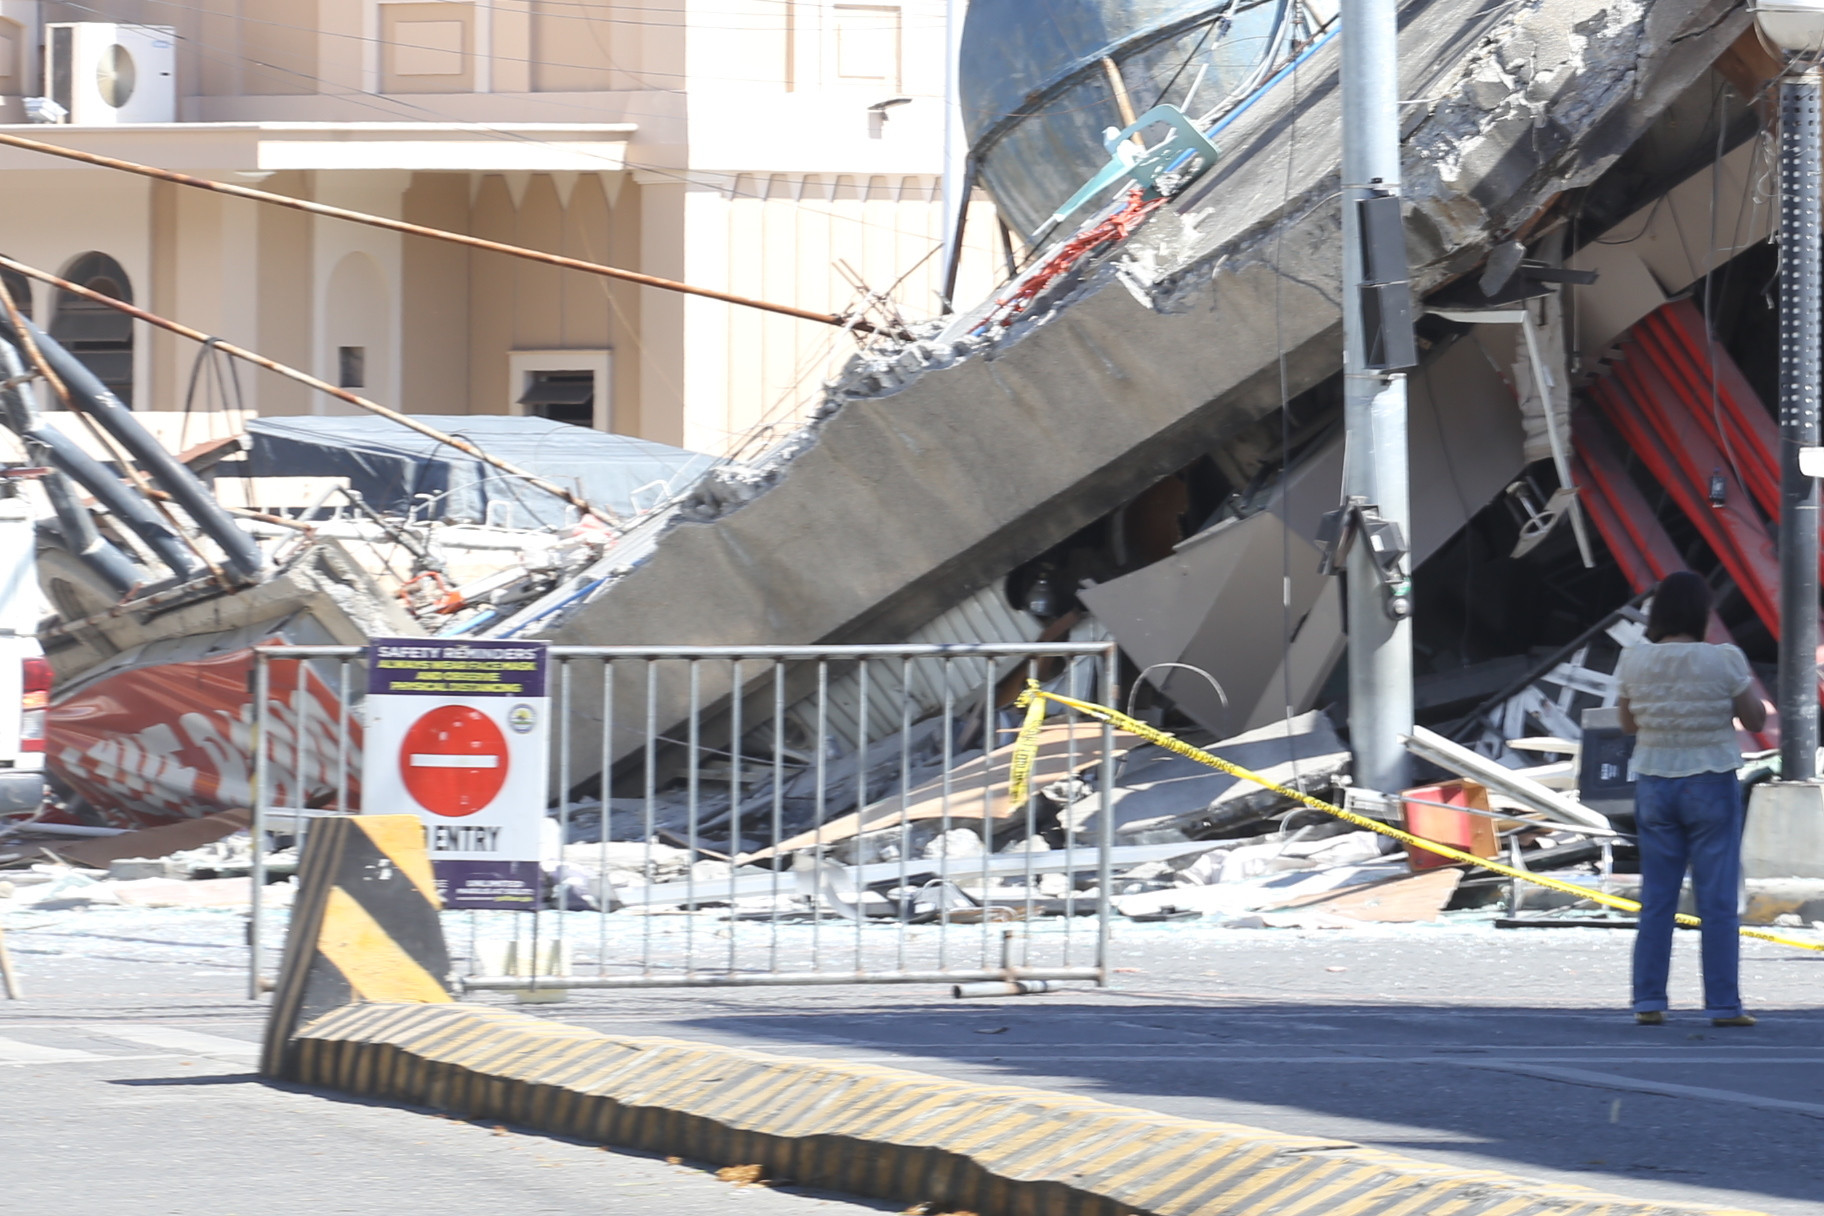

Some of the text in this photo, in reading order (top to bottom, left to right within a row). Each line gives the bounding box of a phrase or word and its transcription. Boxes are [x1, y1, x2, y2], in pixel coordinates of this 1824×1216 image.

[377, 646, 537, 660] SAFETY REMINDERS
[433, 825, 503, 852] ENTRY
